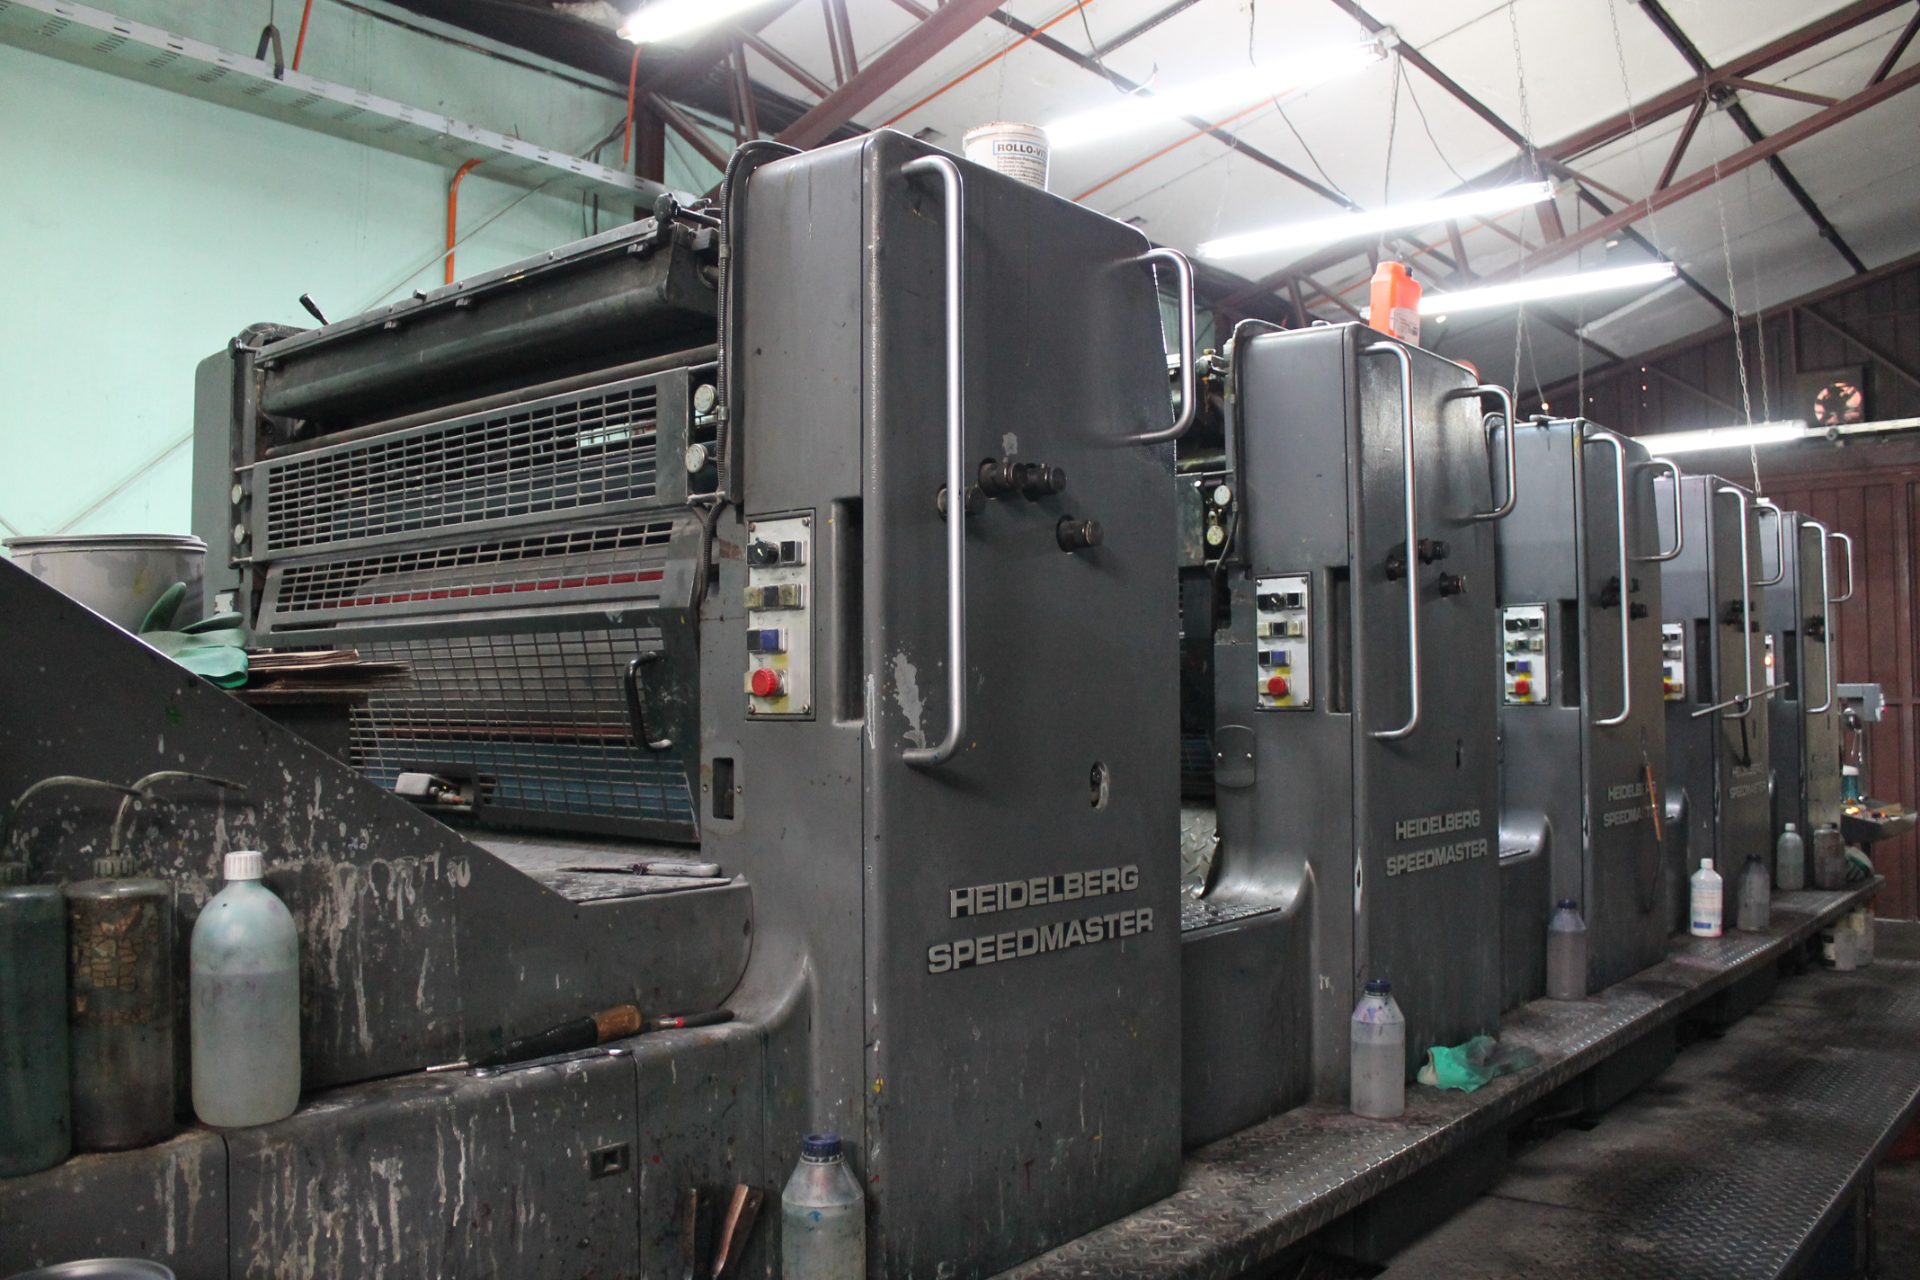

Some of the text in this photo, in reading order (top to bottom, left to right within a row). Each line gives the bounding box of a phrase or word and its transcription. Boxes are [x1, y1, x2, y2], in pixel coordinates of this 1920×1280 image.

[1608, 781, 1656, 801] HEIDELBRG
[1395, 809, 1480, 840] HEIDELBERG
[1603, 805, 1659, 827] SPEEDMAT
[1386, 838, 1488, 877] SPEEDMASTER
[950, 864, 1139, 918] HEIDELBERG
[928, 907, 1154, 974] SPEEDMASTER
